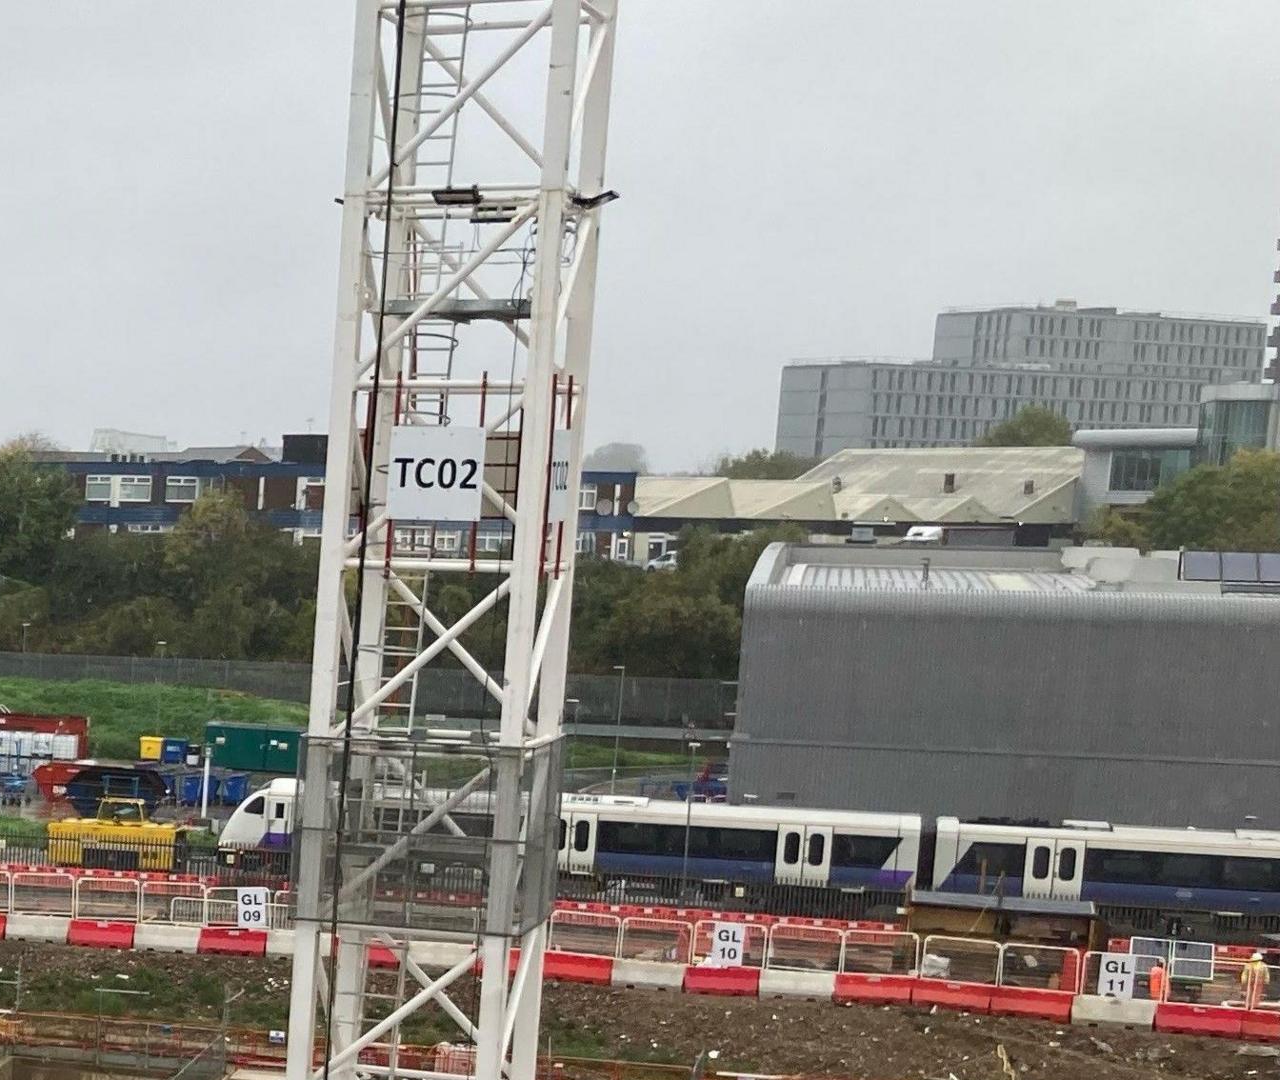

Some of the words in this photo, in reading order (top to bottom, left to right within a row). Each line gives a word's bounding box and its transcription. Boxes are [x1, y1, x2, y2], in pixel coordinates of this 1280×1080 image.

[393, 457, 480, 490] TC02
[552, 460, 569, 491] TC02
[241, 893, 263, 906] GL
[242, 910, 261, 922] 09
[718, 929, 741, 943] GL
[720, 947, 737, 960] 10
[1105, 960, 1131, 974] GL
[1107, 978, 1125, 992] 11
